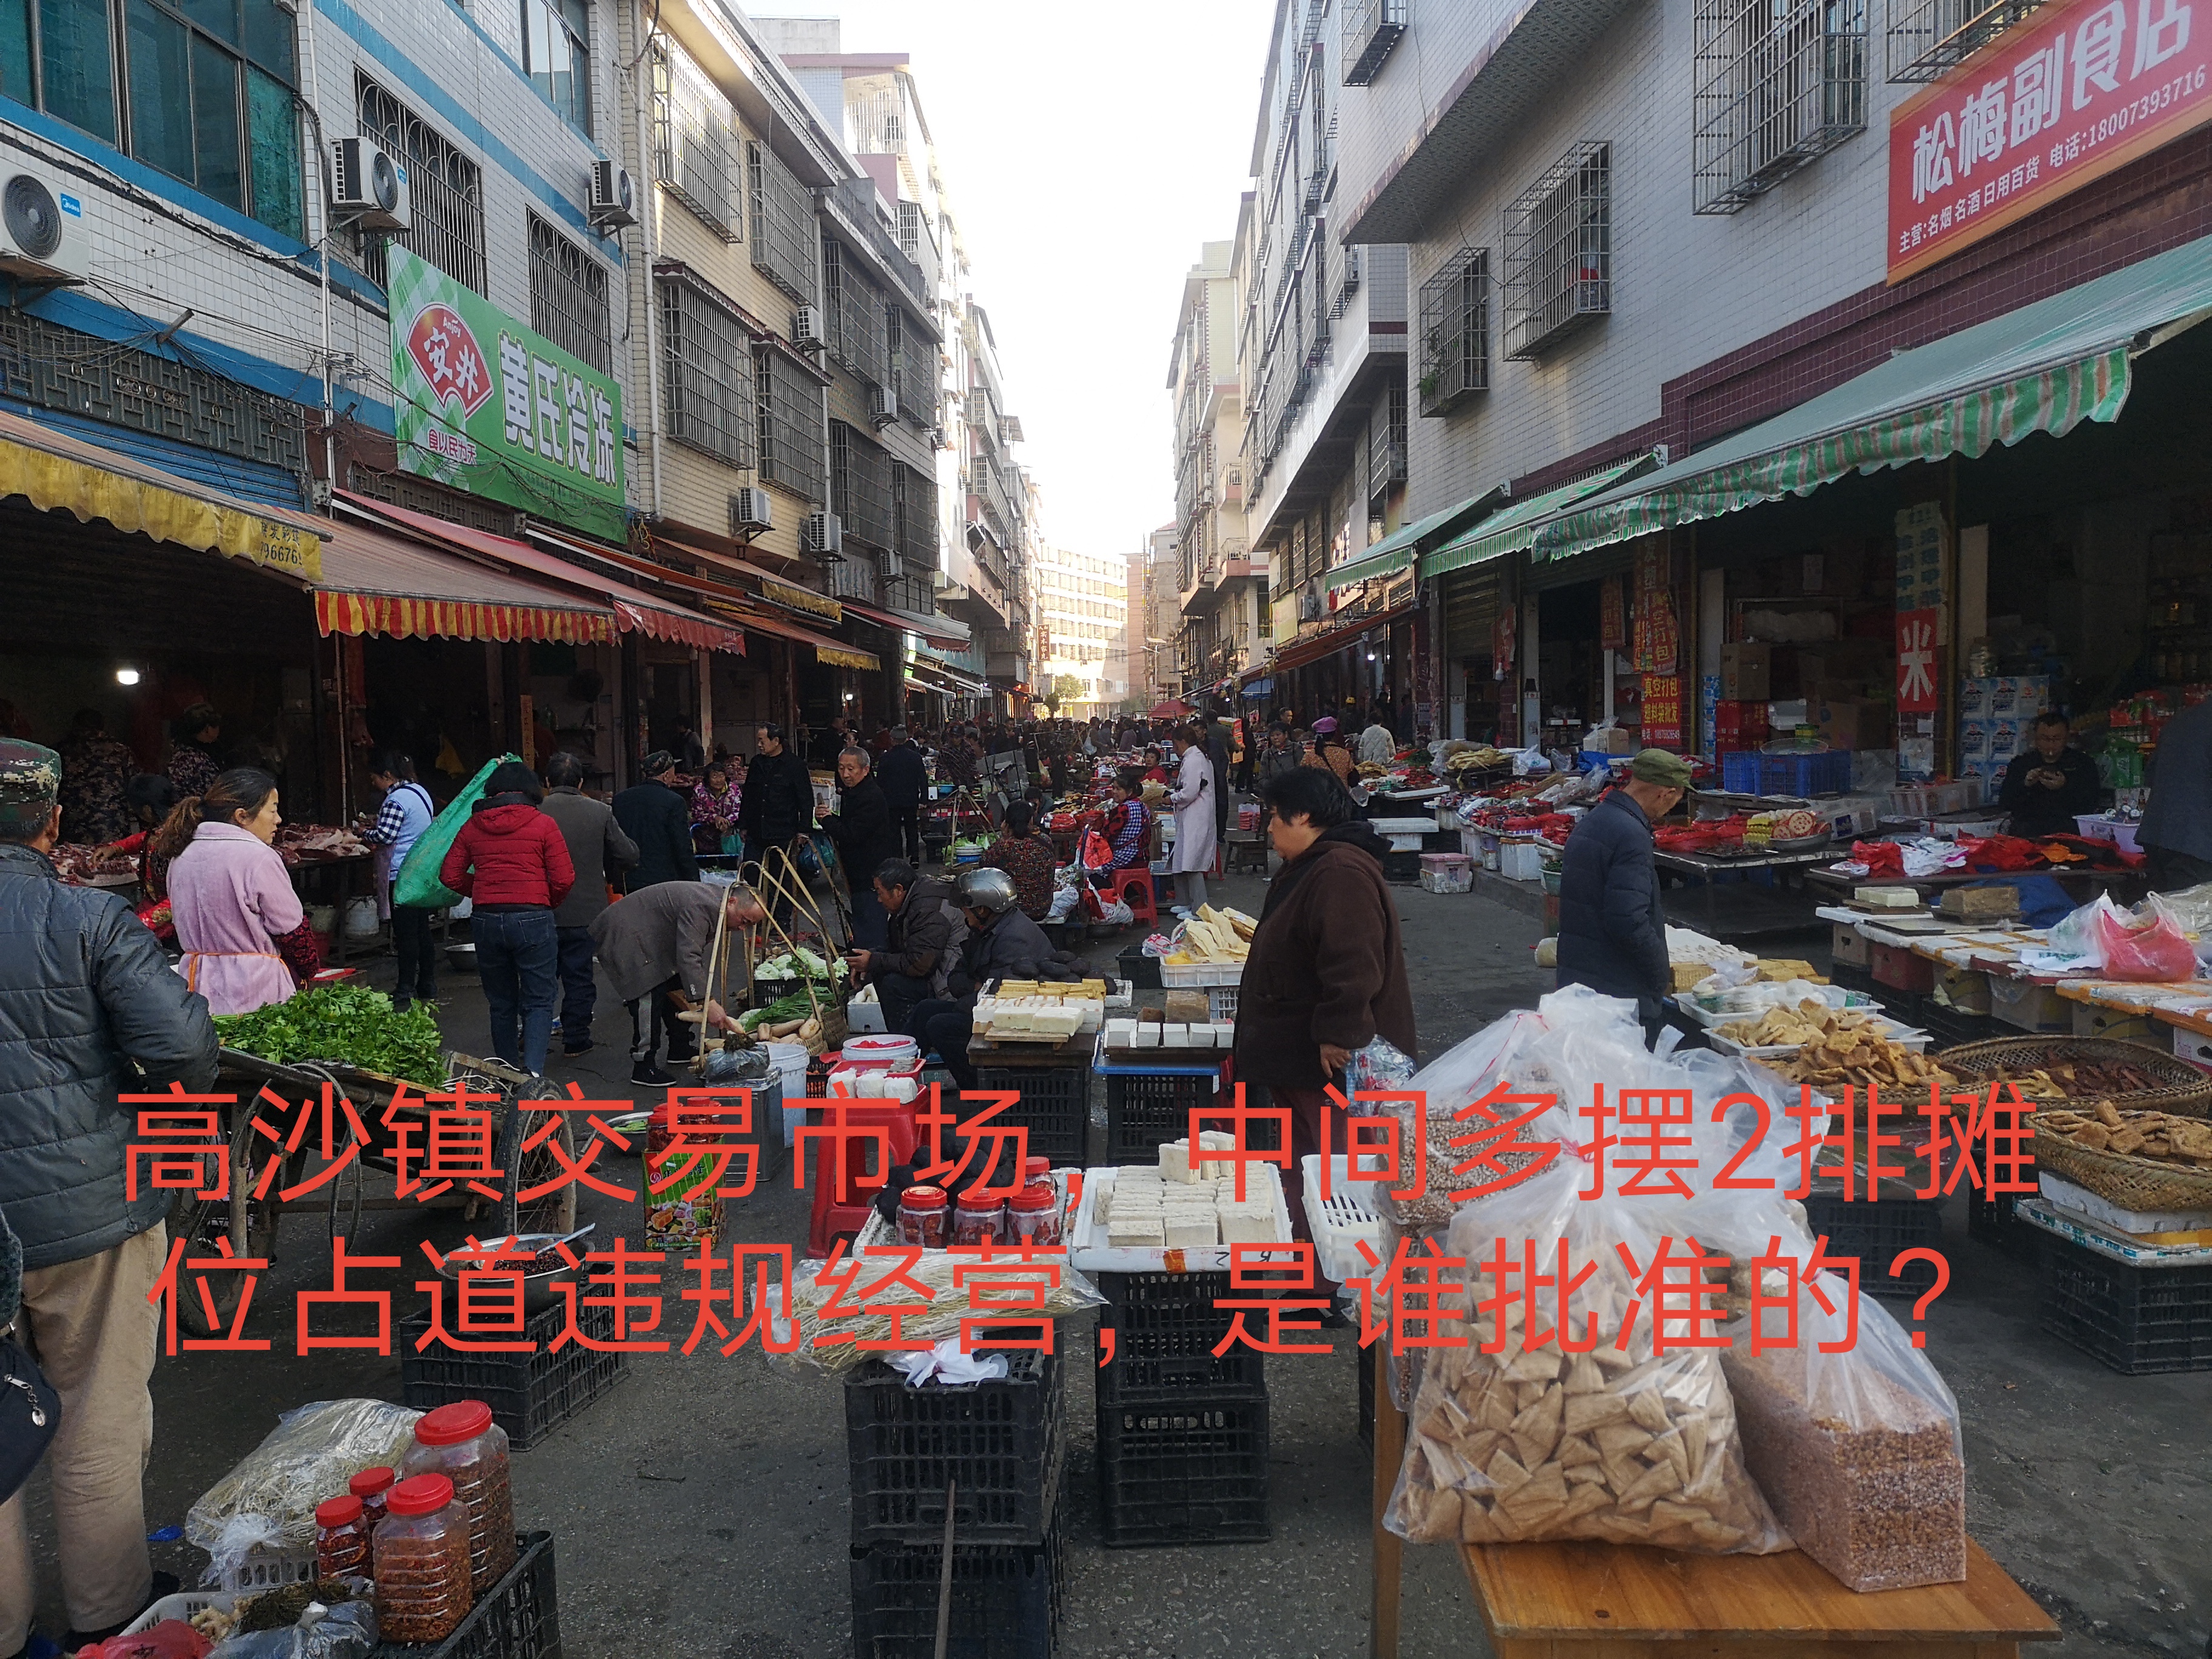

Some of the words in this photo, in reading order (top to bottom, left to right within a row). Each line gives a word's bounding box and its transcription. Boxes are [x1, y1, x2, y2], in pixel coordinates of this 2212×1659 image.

[1912, 0, 2191, 204] 松梅副食店
[1955, 189, 1981, 224] 名酒
[1984, 156, 2040, 207] 日用百货
[443, 316, 462, 338] Anjoy
[424, 327, 479, 400] 安井
[499, 332, 617, 487] 黄氏冷冻
[429, 428, 477, 465] 食以民为天
[1644, 676, 1678, 698] 真空打包
[1899, 620, 1933, 702] 米
[1644, 702, 1678, 723] 塑料袋批发
